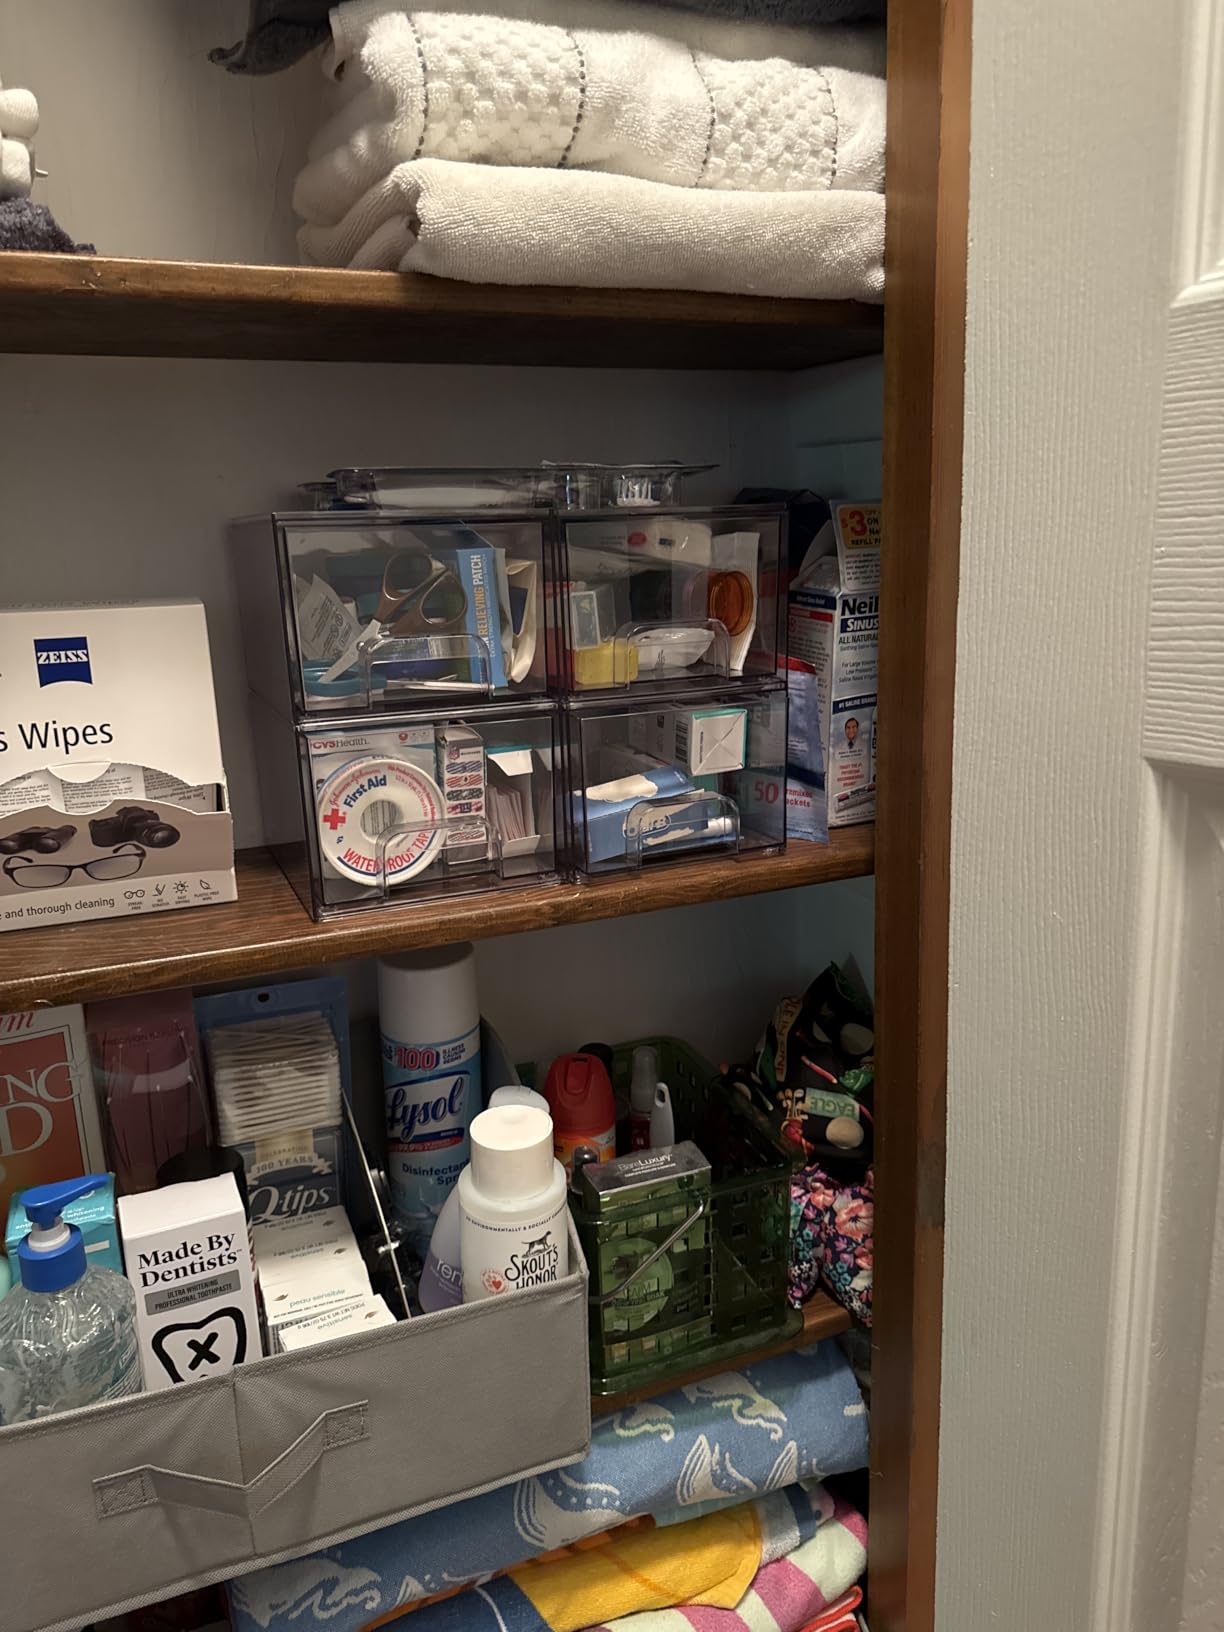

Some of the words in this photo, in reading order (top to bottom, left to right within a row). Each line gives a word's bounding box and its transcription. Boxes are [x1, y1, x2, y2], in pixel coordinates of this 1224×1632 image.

[470, 554, 483, 586] PATCH
[474, 587, 488, 636] RELIEVING
[841, 596, 879, 617] Neil
[846, 618, 879, 632] SINUS
[839, 636, 851, 645] ALL
[37, 650, 88, 665] ZEISS
[18, 720, 114, 755] Wipes
[343, 784, 368, 809] First
[367, 775, 388, 791] Aid
[754, 777, 779, 804] 50
[4, 907, 24, 920] and
[26, 902, 72, 917] thorough
[75, 896, 115, 912] cleaning
[395, 1046, 440, 1072] 100
[386, 1076, 465, 1143] Lysol
[255, 1161, 275, 1174] 100
[277, 1155, 313, 1168] YEARS
[436, 1174, 458, 1186] Spr
[137, 1241, 202, 1270] Made
[206, 1233, 236, 1252] By
[505, 1243, 559, 1281] SKOUT'S
[140, 1250, 238, 1288] Dentists
[436, 1258, 463, 1286] ren
[154, 1294, 198, 1311] PROFESSIONAL
[197, 1283, 233, 1299] TOOTHPASTE
[167, 1288, 186, 1299] ULTRA
[186, 1279, 219, 1294] WHITENING
